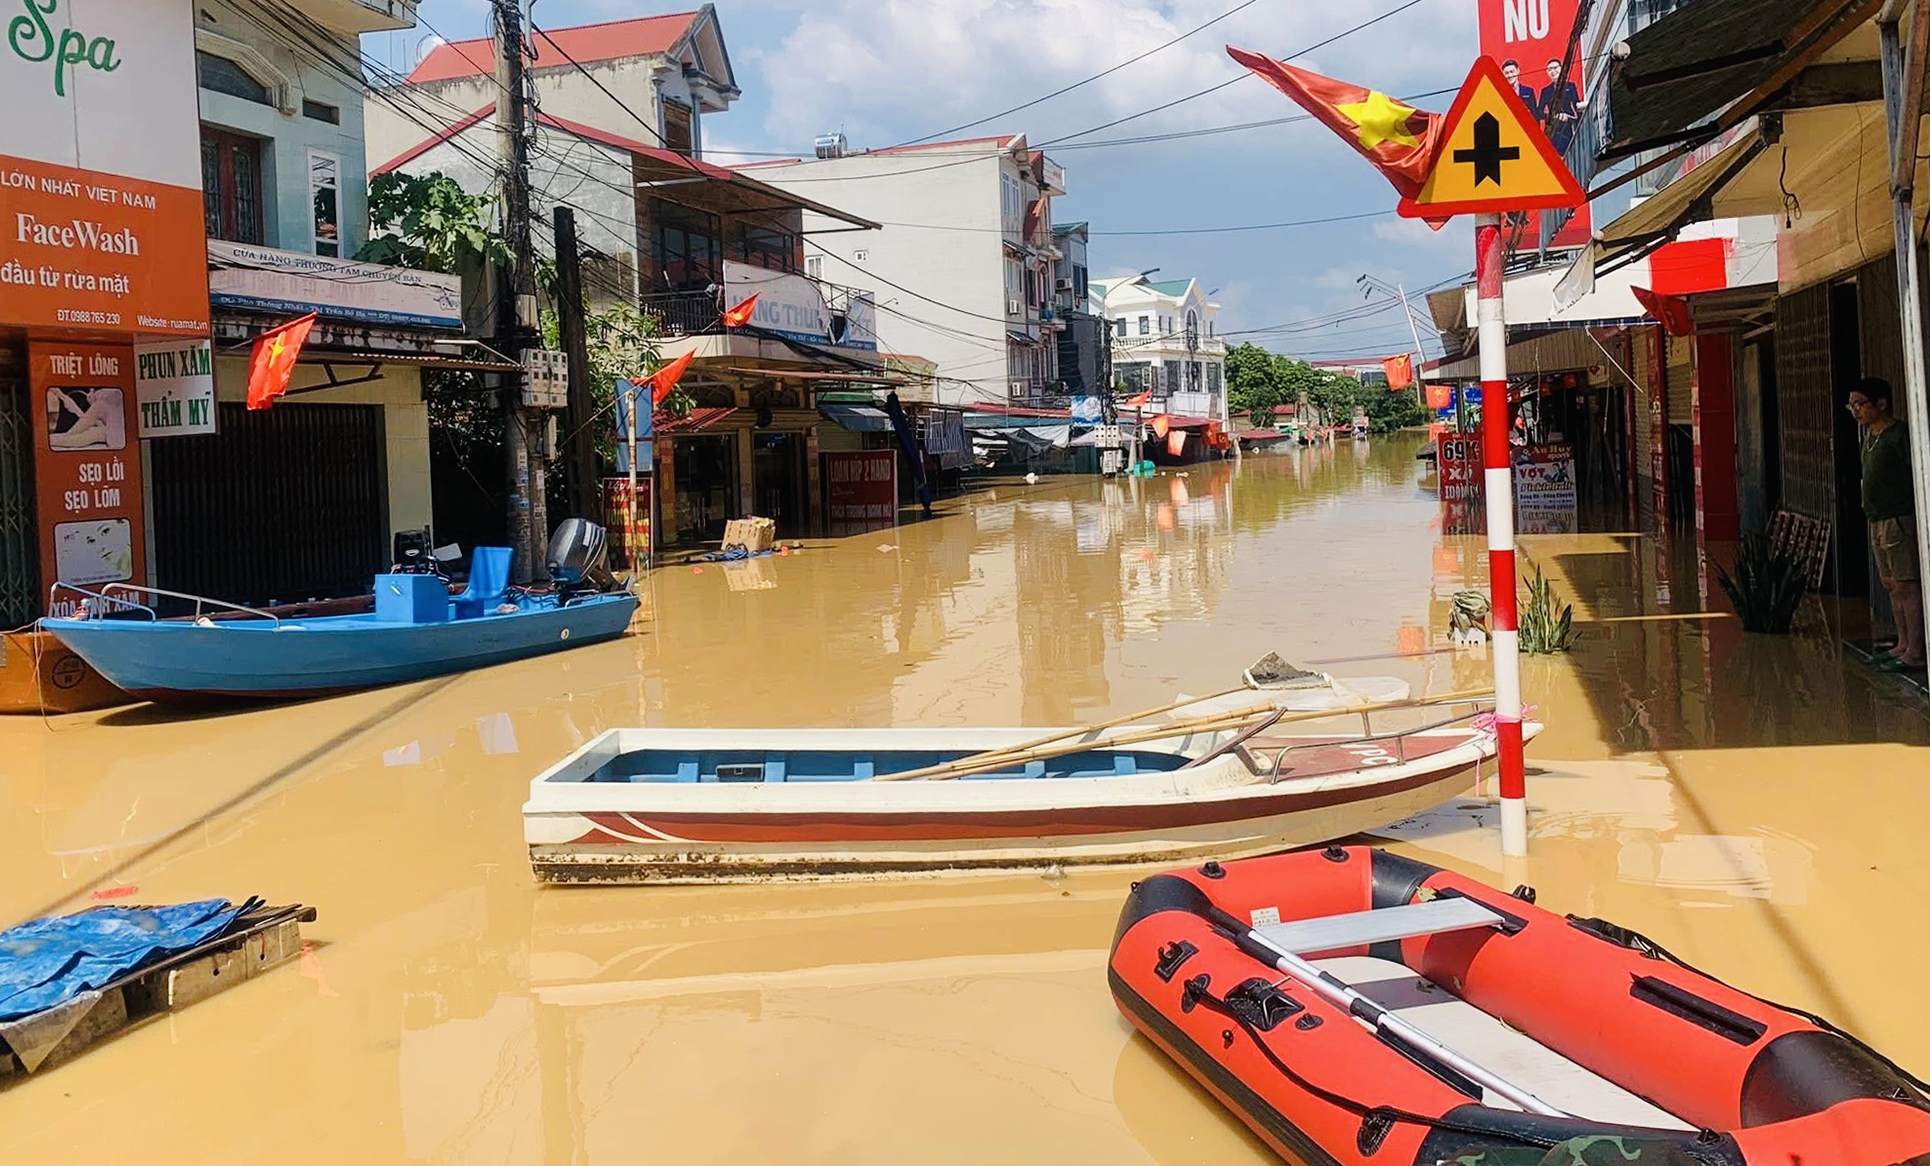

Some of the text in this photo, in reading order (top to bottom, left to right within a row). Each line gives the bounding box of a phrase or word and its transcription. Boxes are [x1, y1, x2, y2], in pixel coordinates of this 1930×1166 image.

[8, 0, 121, 97] Spa
[1, 168, 156, 209] LỚN NHẤT VIỆT NAM
[15, 212, 139, 256] FaceWash
[0, 258, 35, 285] đầu
[99, 274, 130, 299] mặt
[50, 352, 119, 379] TRIỆT LÔNG
[138, 345, 211, 380] PHUN XĂM
[141, 390, 212, 428] THẨM MỸ
[79, 463, 102, 486] SẸO
[65, 485, 121, 514] SẸO LÕM
